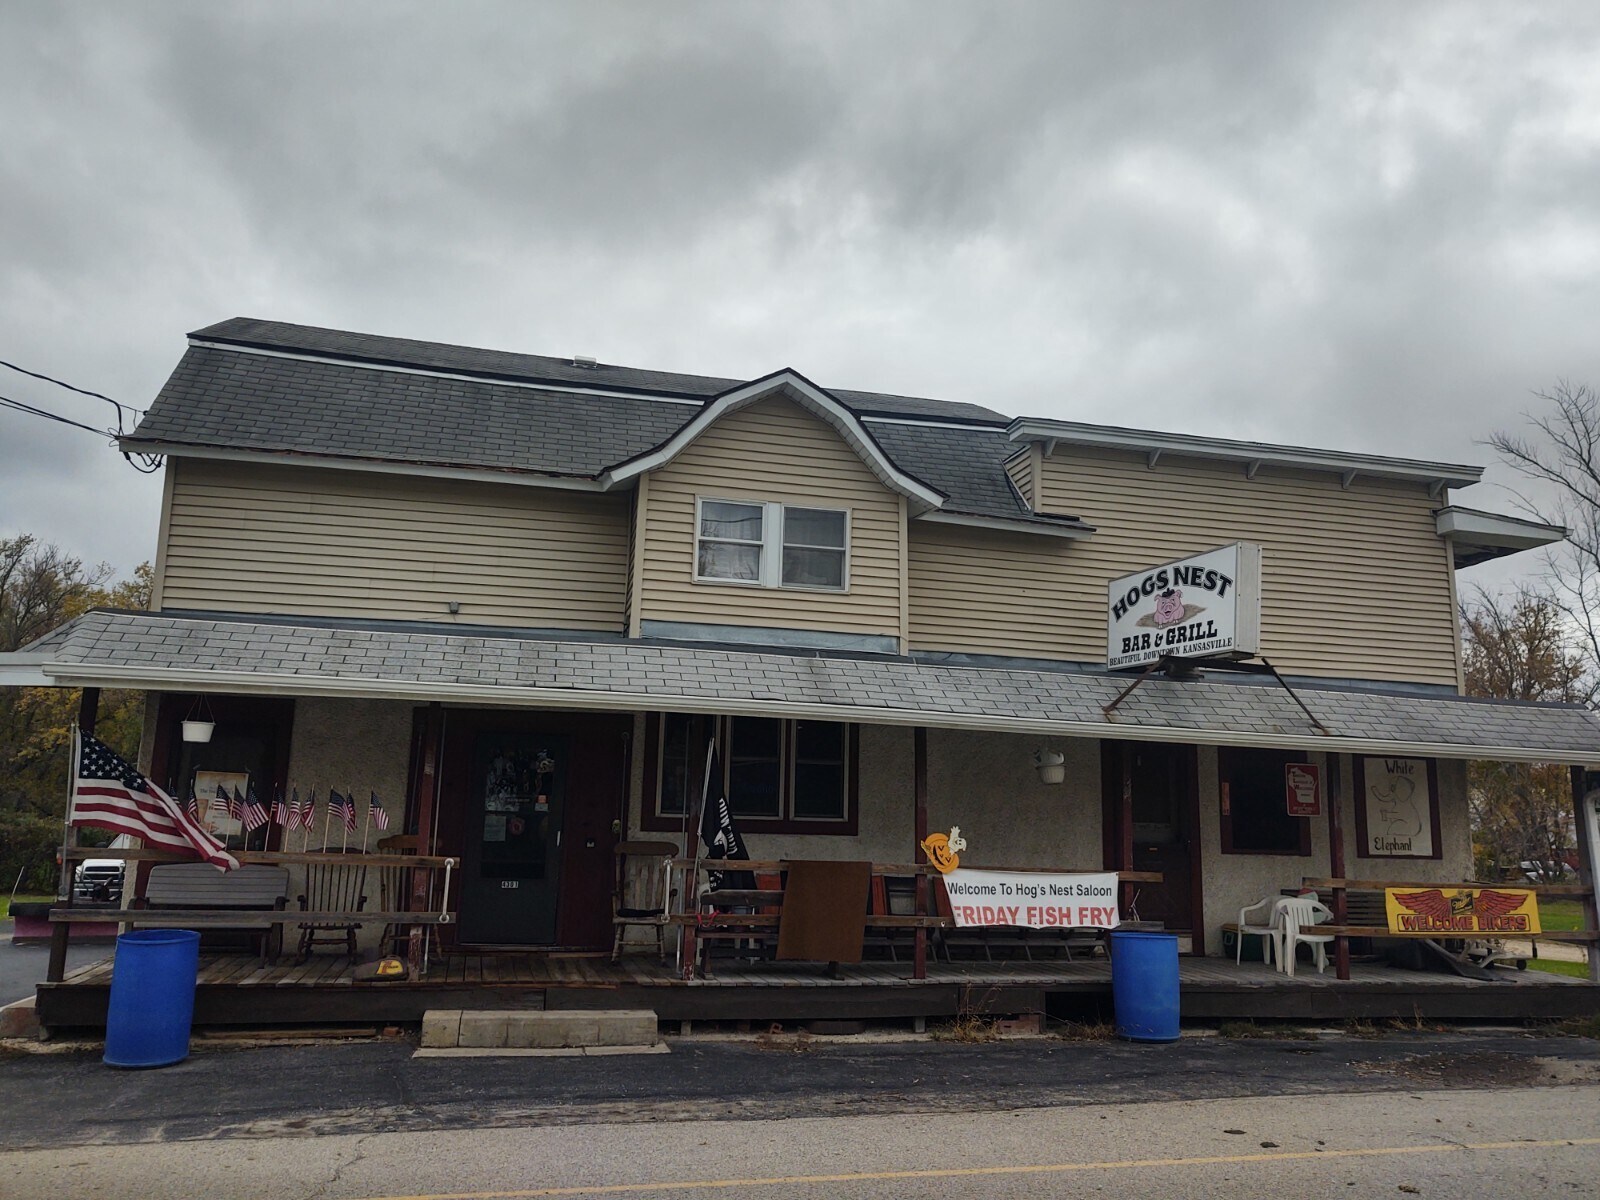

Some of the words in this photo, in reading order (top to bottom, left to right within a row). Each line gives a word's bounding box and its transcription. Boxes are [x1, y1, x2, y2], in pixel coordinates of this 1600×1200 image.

[1111, 568, 1169, 623] HOGS
[1173, 565, 1233, 598] NEST
[1121, 633, 1151, 654] BAR
[1154, 633, 1163, 648] &
[1166, 620, 1218, 646] GRILL
[1109, 653, 1141, 667] BEAUTIFUL
[1182, 637, 1233, 654] KANSASVILLE
[1385, 760, 1415, 775] White
[1374, 837, 1412, 855] Elephant
[947, 882, 997, 896] Welcome
[999, 883, 1013, 896] To
[1016, 883, 1046, 899] Hog's
[1049, 884, 1074, 897] Nest
[1076, 884, 1112, 897] Saloon
[1026, 906, 1072, 926] FISH
[1078, 907, 1115, 926] FRY
[1402, 915, 1474, 931] WELCOME
[1477, 916, 1527, 931] BIKERS
